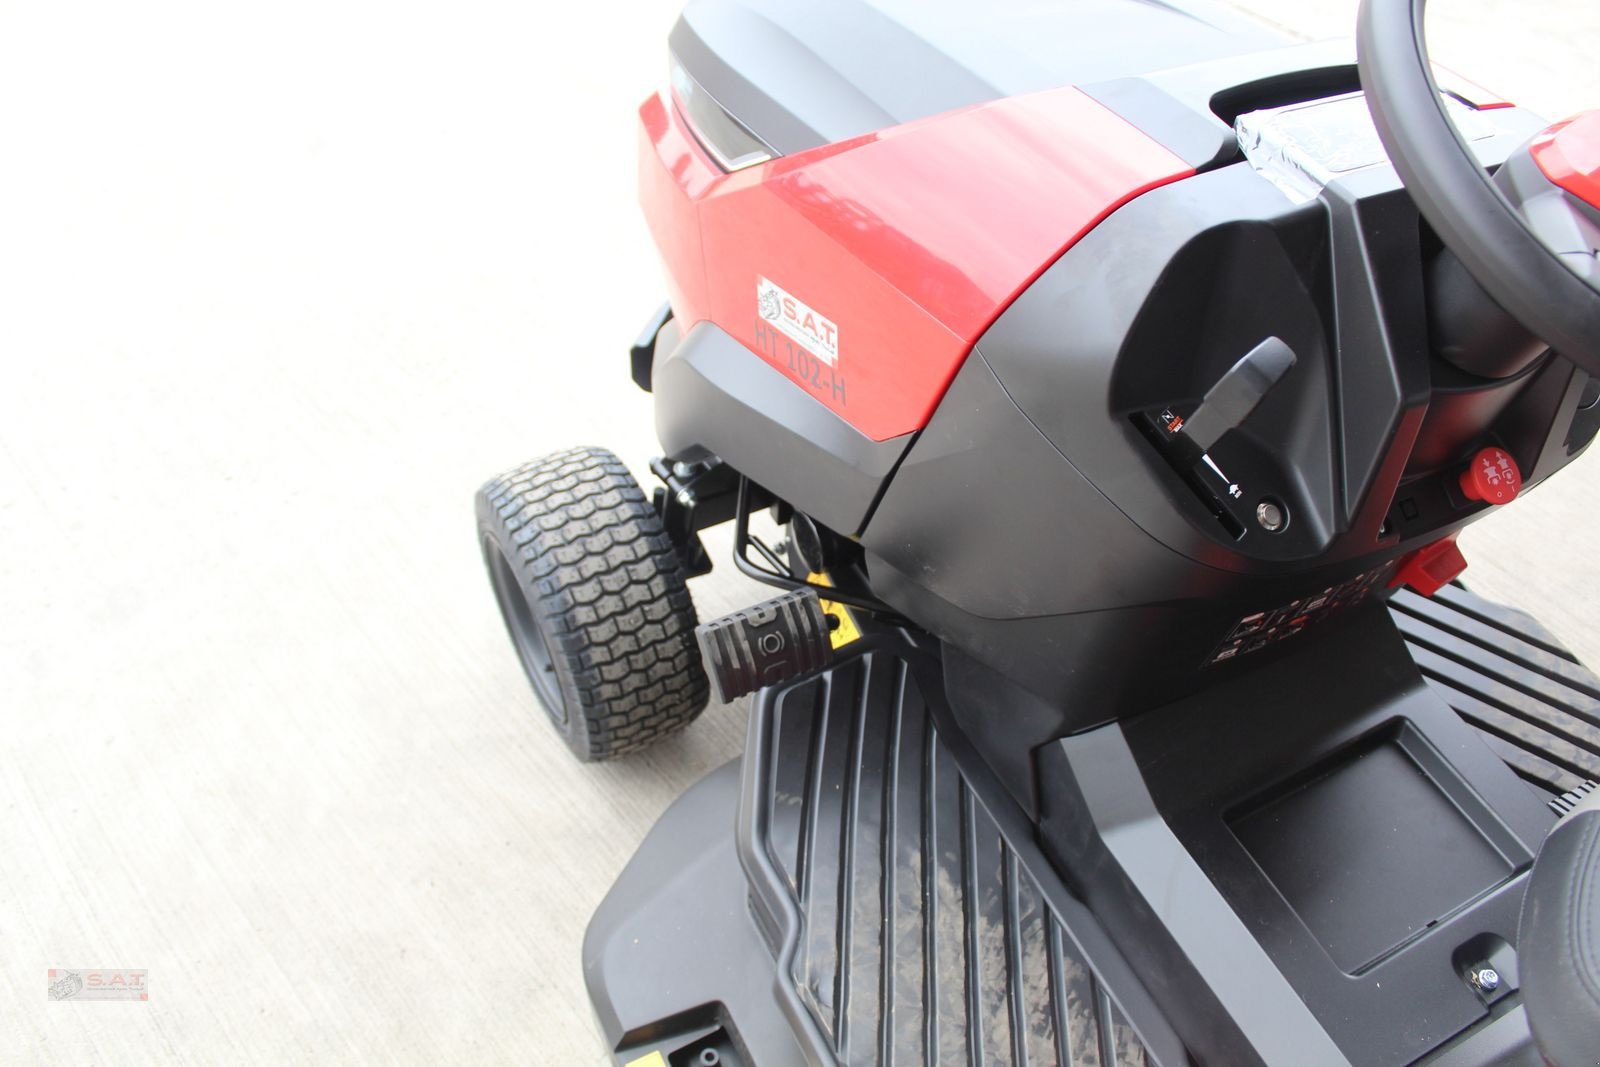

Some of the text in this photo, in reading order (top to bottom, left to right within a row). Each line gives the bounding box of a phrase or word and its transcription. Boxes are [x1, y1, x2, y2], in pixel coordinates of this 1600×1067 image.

[782, 297, 835, 348] S.A.T.
[754, 320, 778, 358] HT
[786, 342, 847, 406] 102-H
